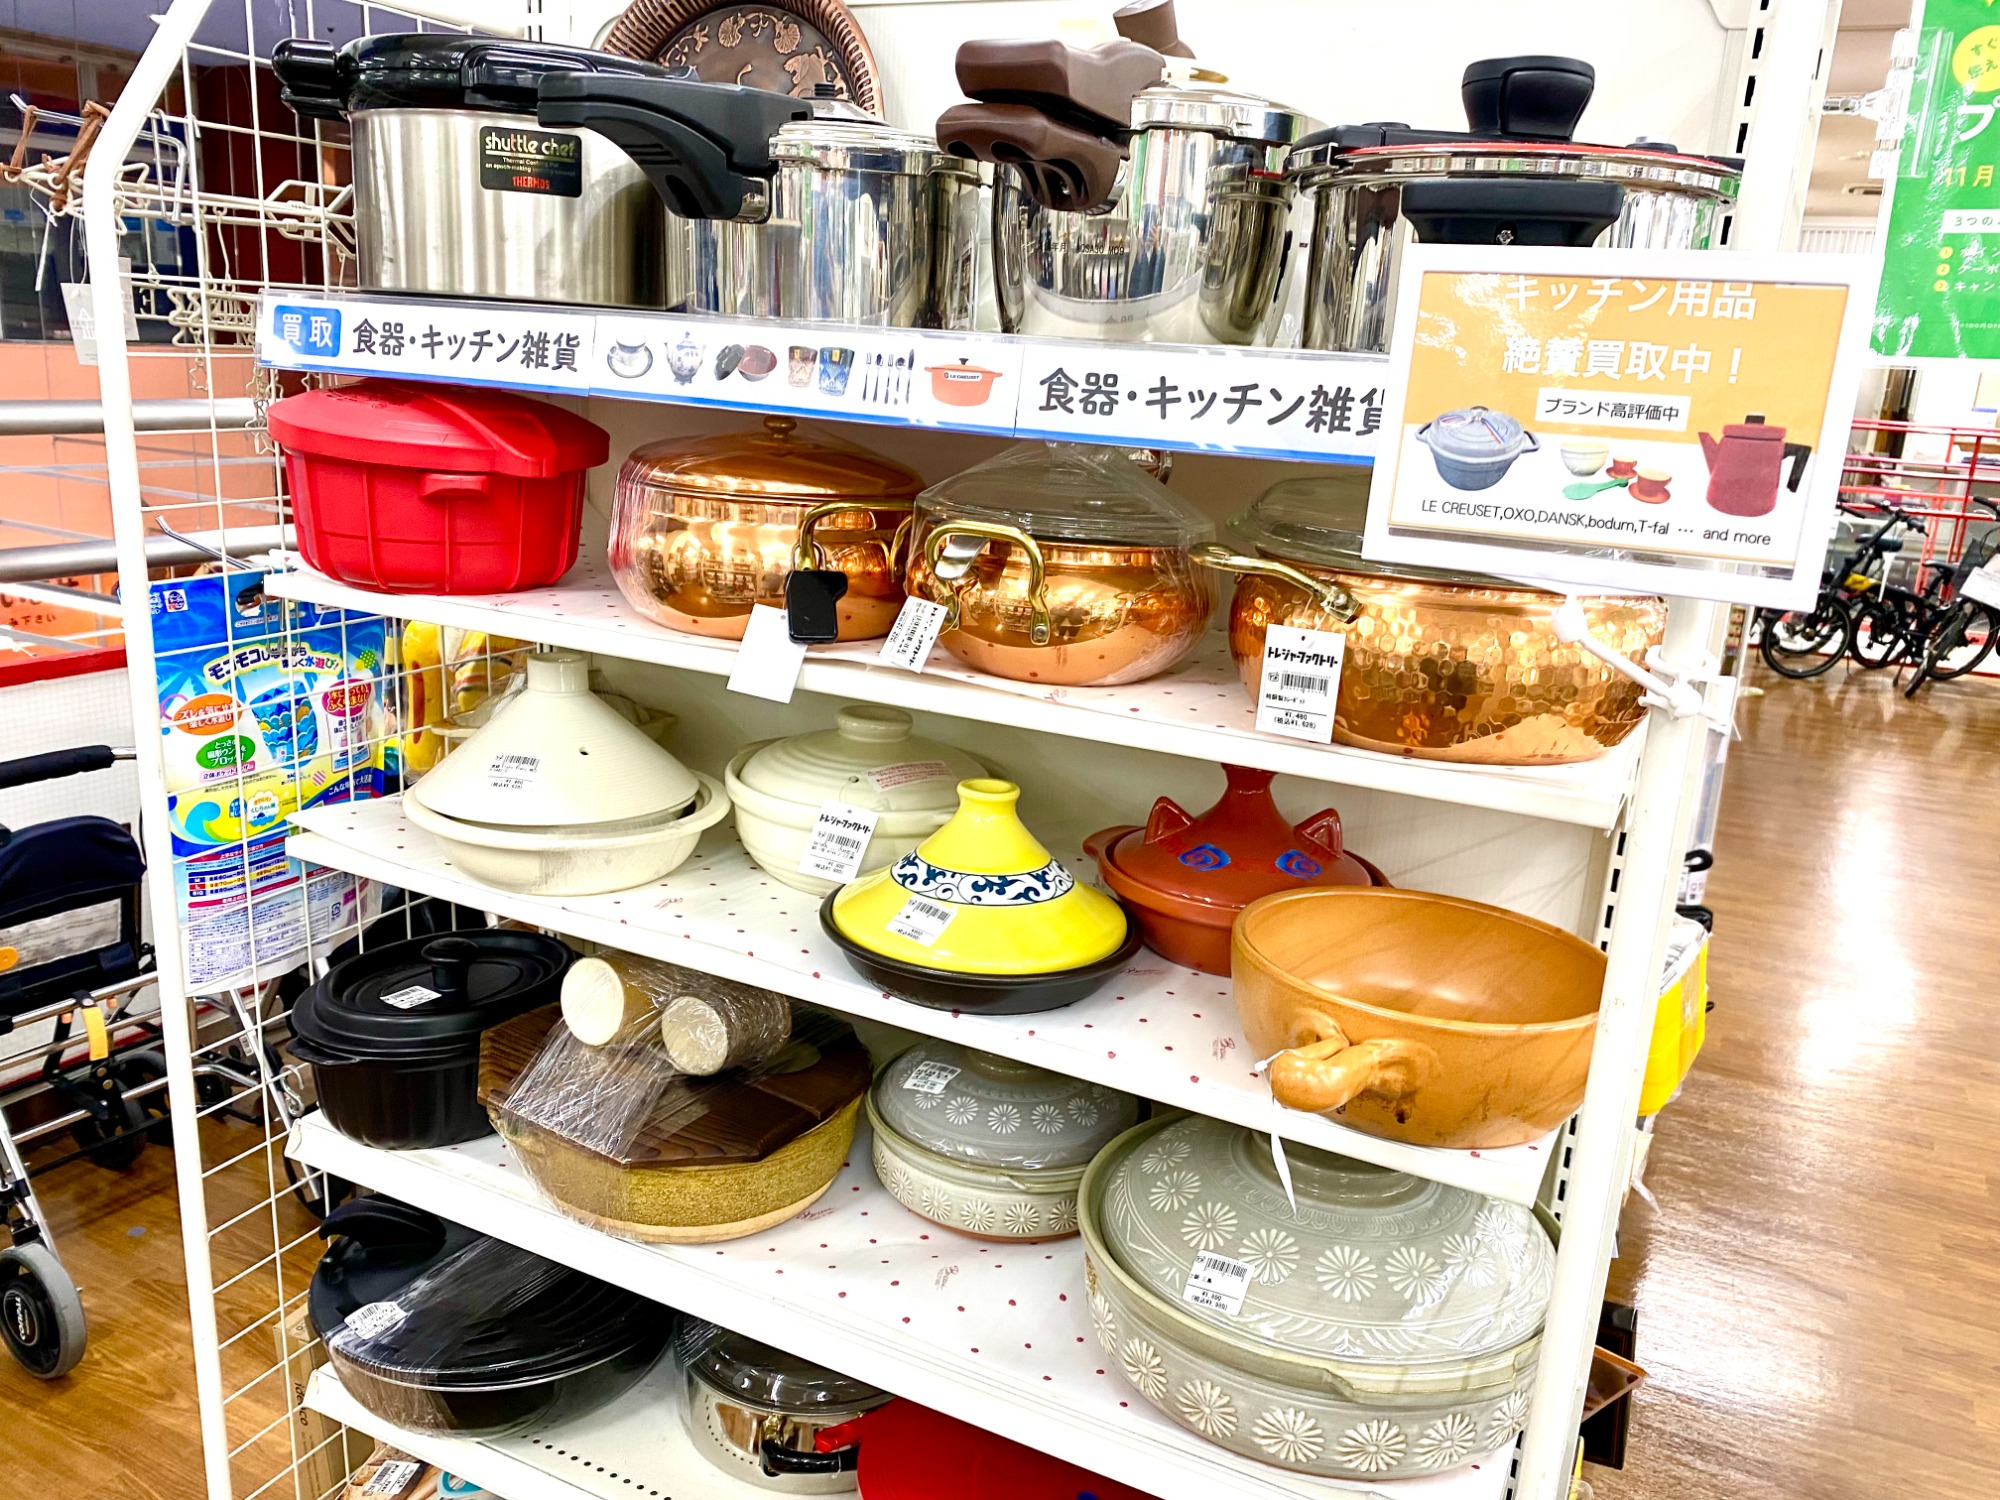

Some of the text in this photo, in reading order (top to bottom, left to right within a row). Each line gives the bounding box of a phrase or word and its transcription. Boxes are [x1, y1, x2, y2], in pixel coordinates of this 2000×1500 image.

[485, 132, 575, 156] shuttle chef
[512, 176, 551, 190] THERMOS
[1945, 166, 1994, 187] 11月
[1955, 216, 2000, 227] 3つの
[1505, 275, 1756, 320] キッチン用品
[282, 314, 580, 372] 買取 食器・キッチン雑貨
[1545, 397, 1680, 422] ブランド高評価中
[1421, 500, 1437, 513] LE
[1704, 528, 1731, 542] and
[1733, 532, 1771, 546] more
[1268, 646, 1338, 668] トレジャーファクトリー
[819, 814, 871, 834] トレジャーファクトリー
